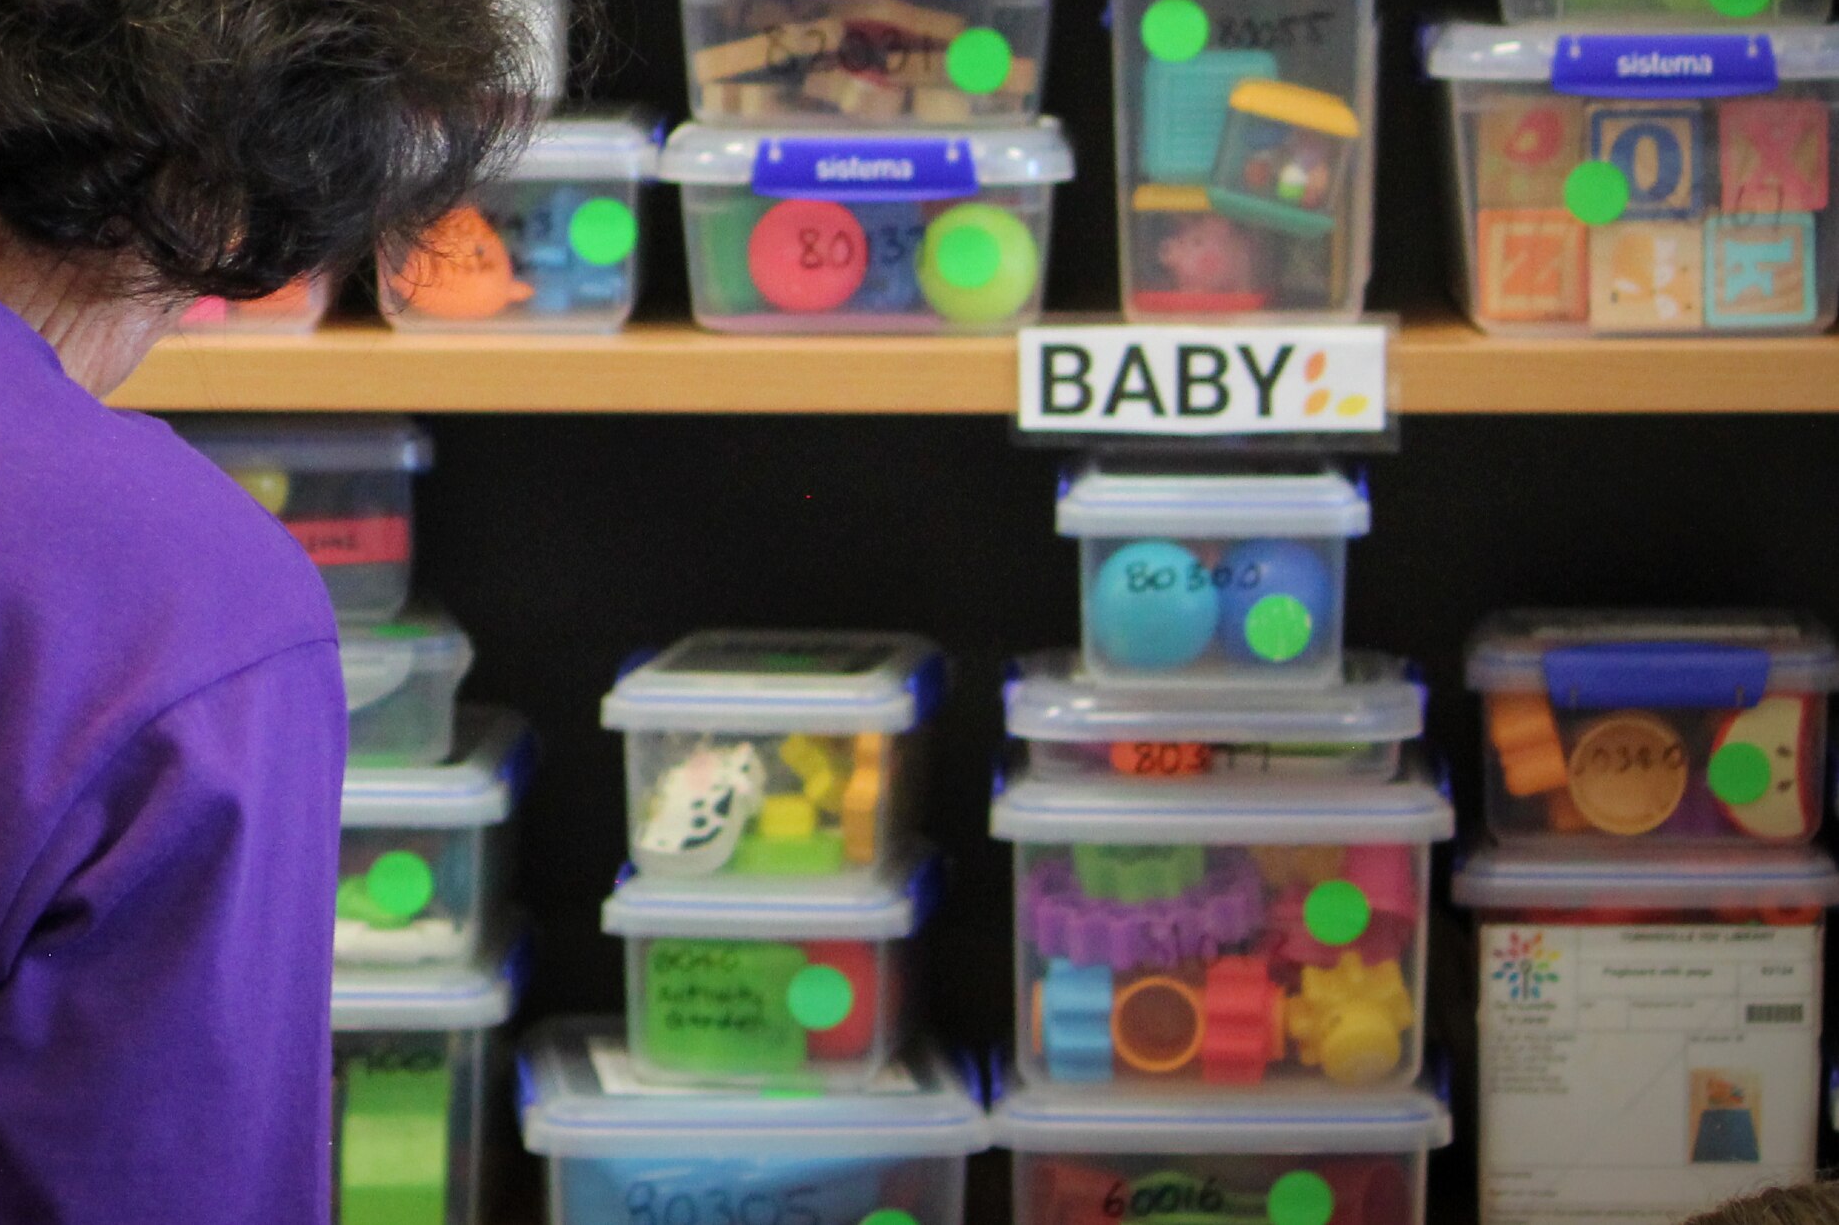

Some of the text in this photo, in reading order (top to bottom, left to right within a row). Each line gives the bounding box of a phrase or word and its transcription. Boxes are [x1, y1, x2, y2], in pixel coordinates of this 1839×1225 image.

[1616, 51, 1713, 77] sistema
[815, 155, 914, 181] sistema
[1041, 344, 1295, 417] BABY
